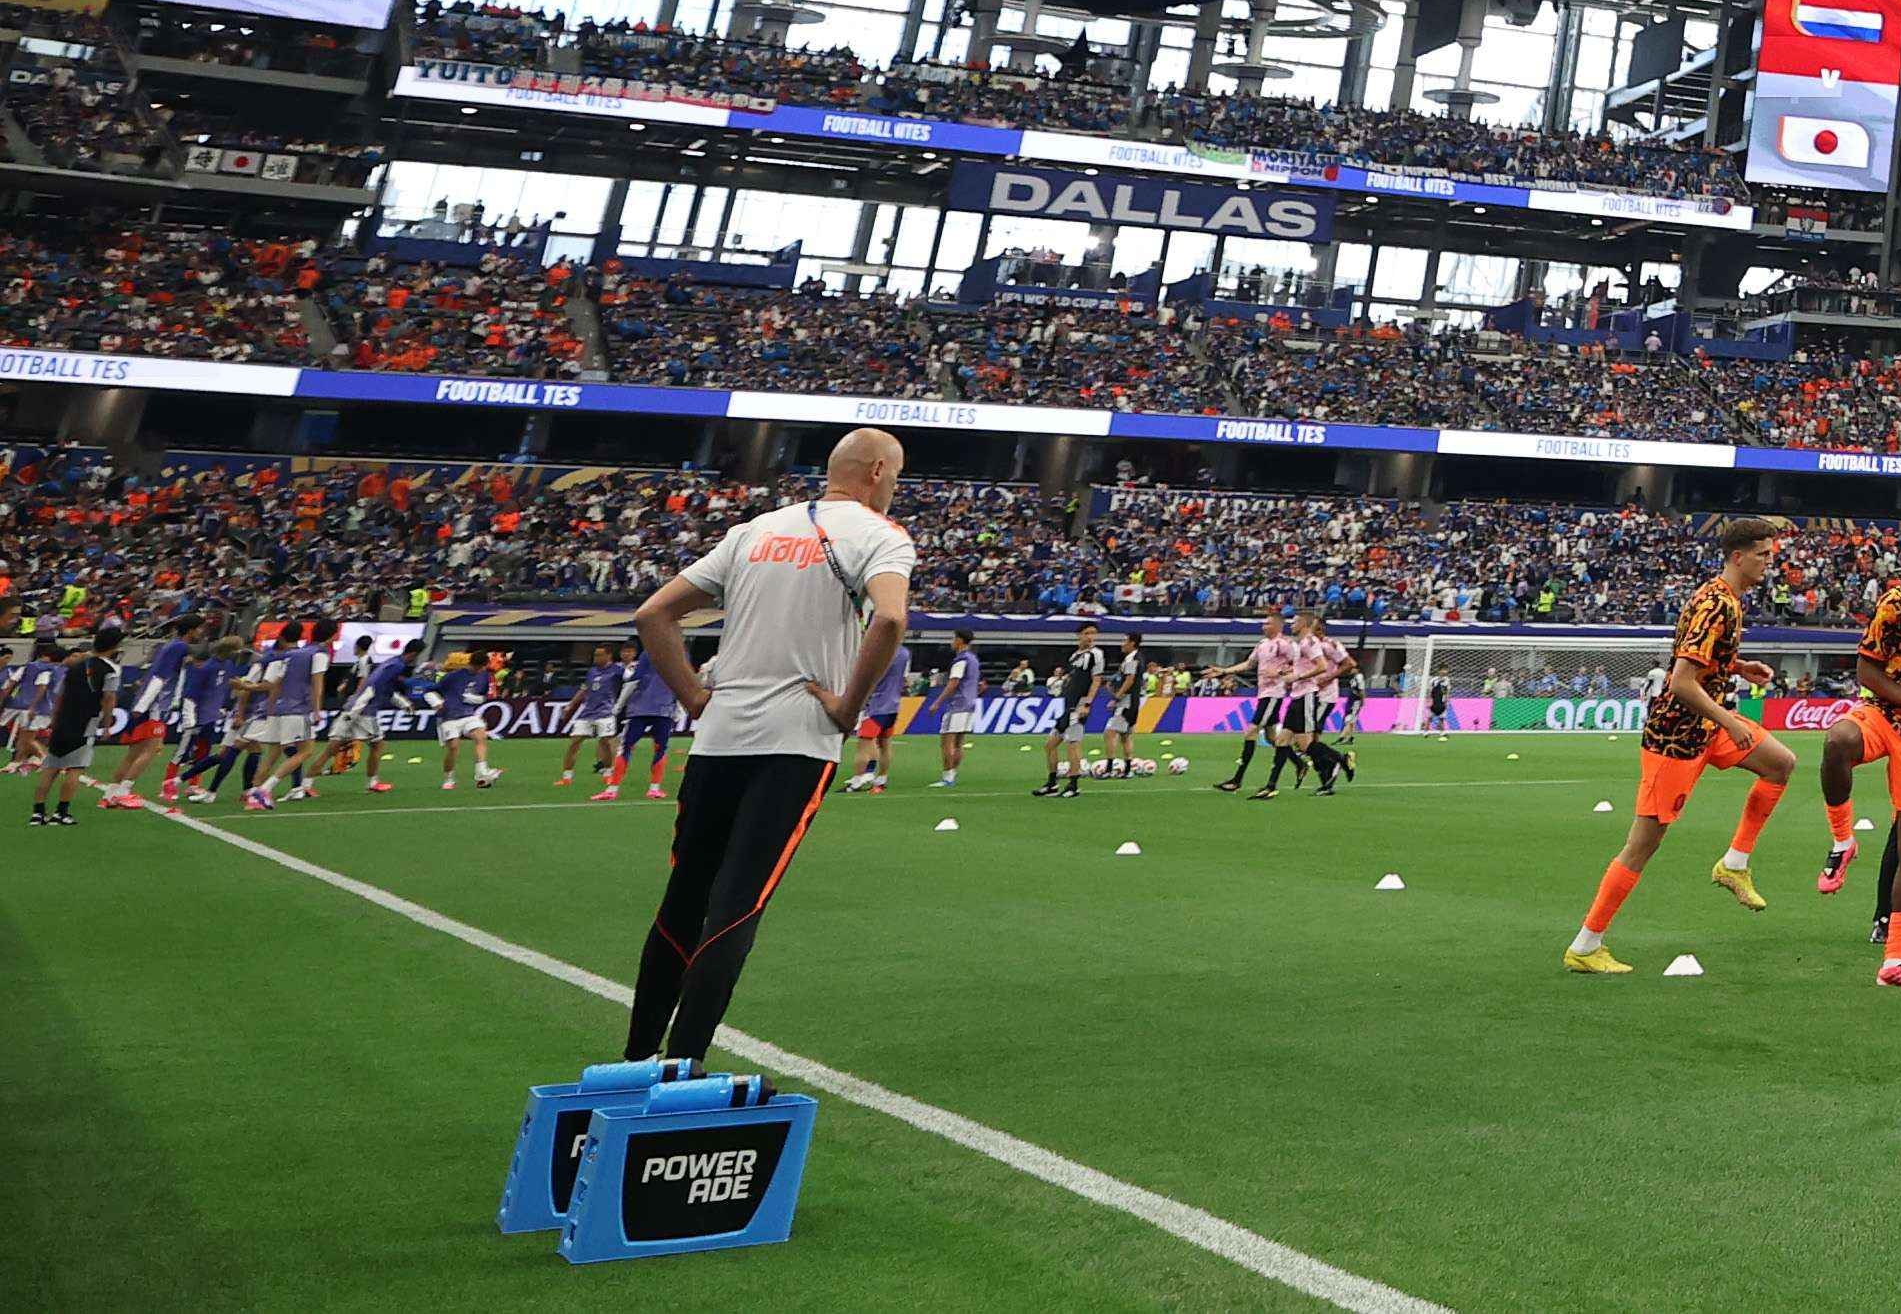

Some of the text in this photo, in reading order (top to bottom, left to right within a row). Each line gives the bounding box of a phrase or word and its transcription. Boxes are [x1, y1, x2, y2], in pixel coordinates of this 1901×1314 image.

[988, 172, 1318, 238] DALLAS
[1072, 297, 1098, 308] CUP
[970, 697, 1065, 733] VISA
[641, 1149, 758, 1184] POWER
[687, 1173, 754, 1205] ADE
